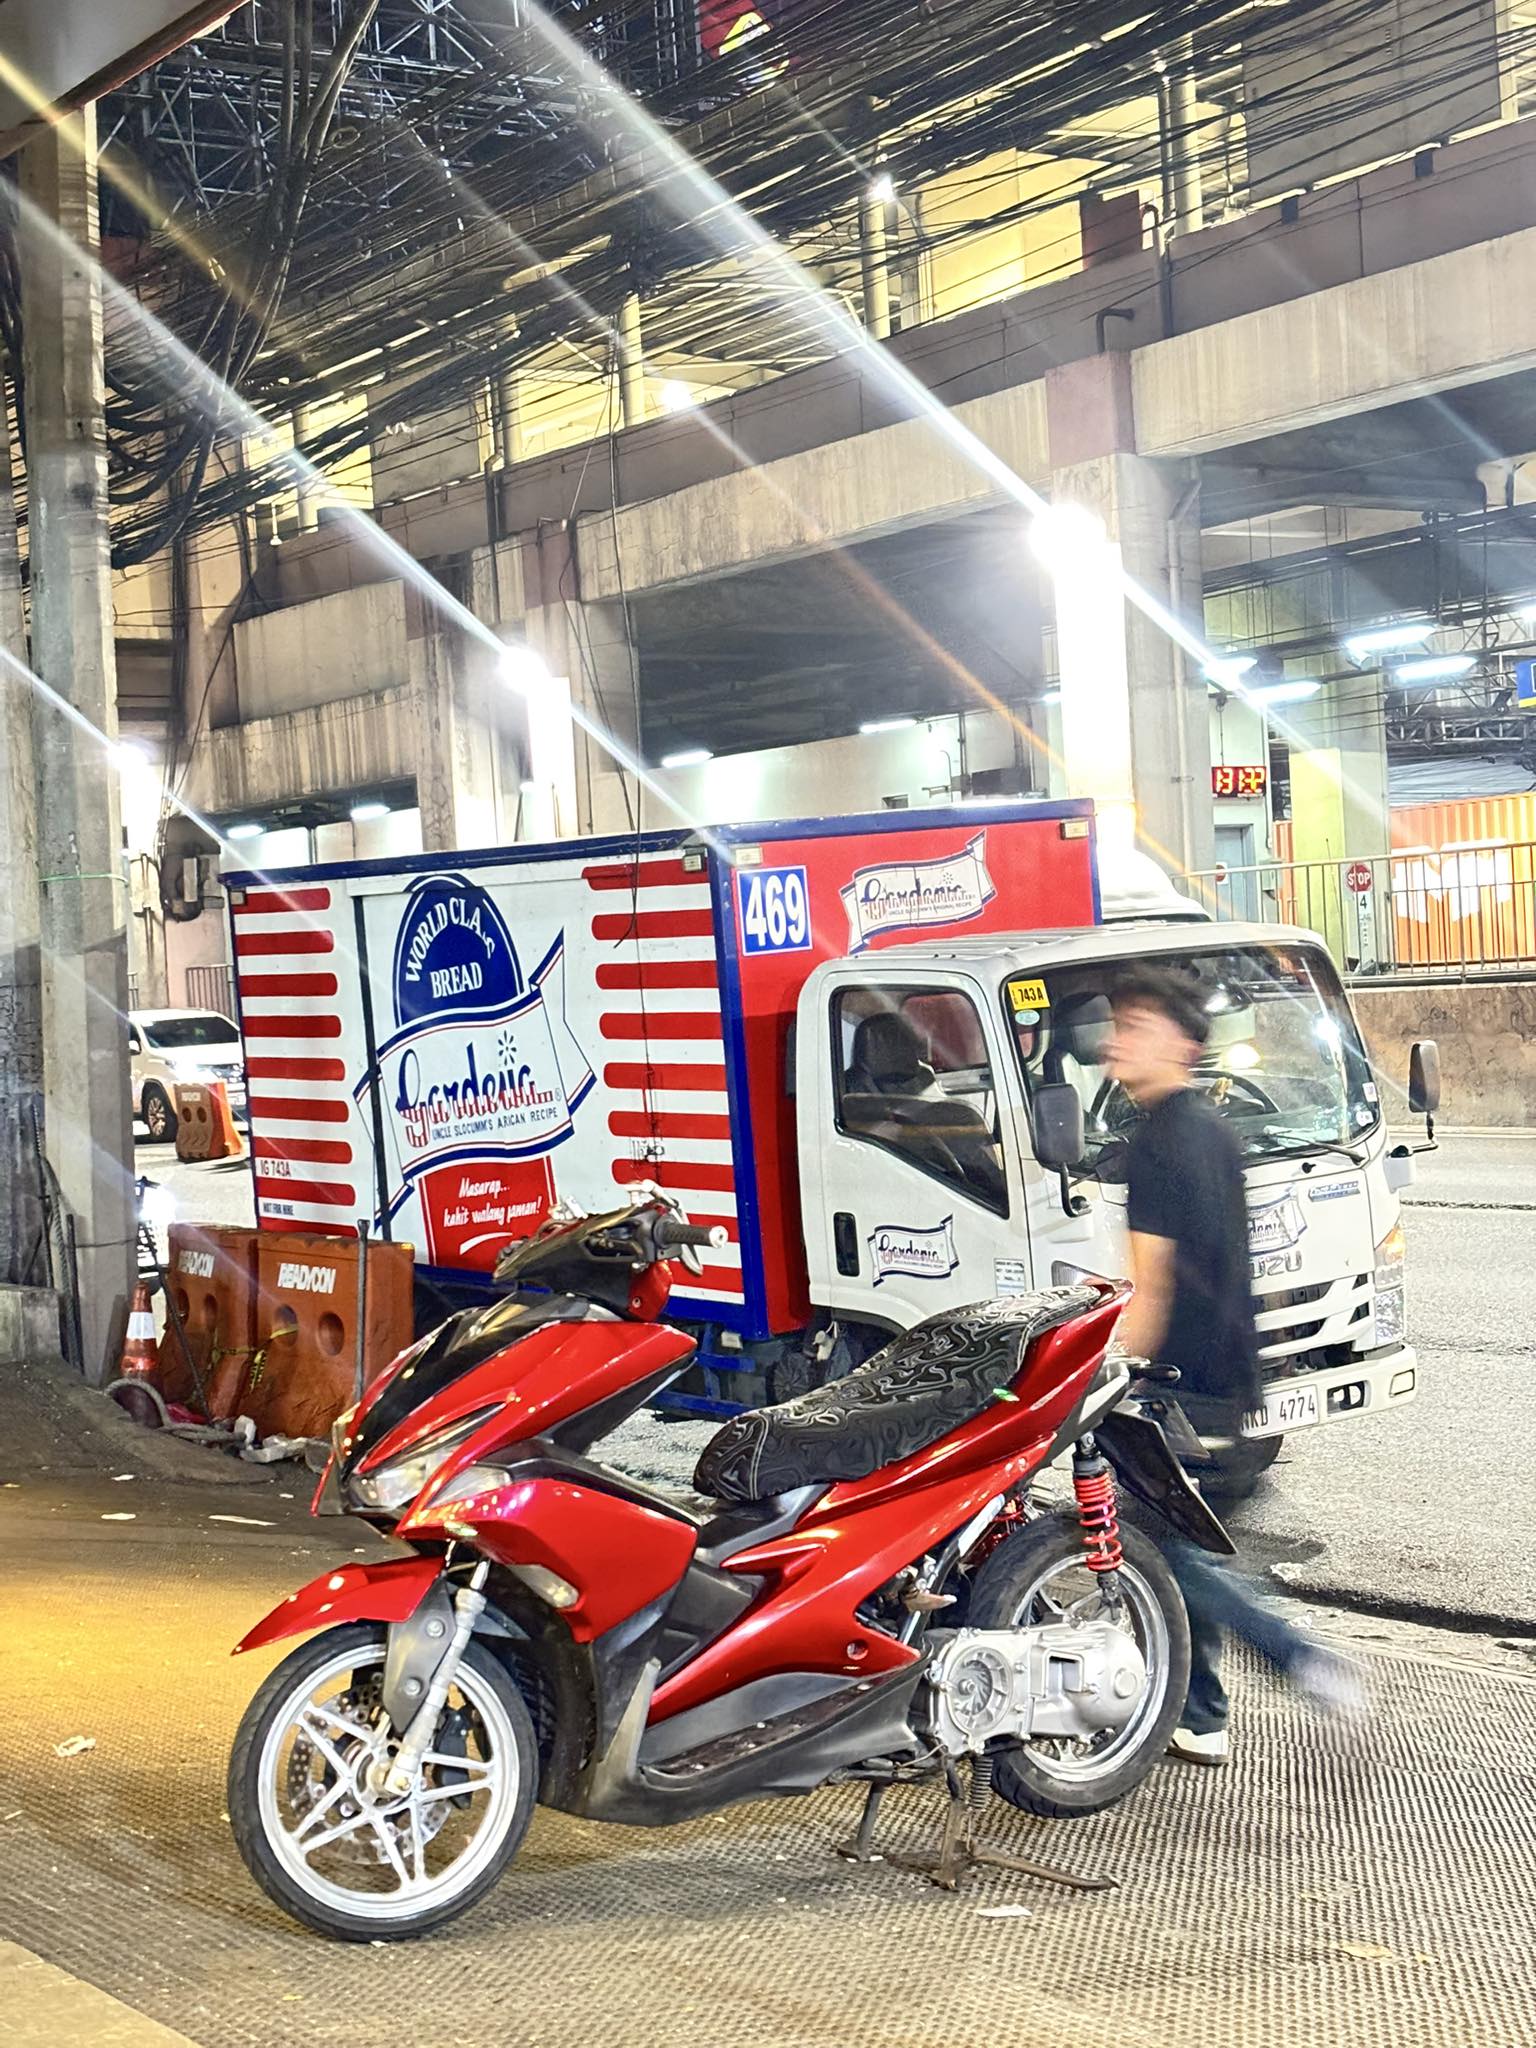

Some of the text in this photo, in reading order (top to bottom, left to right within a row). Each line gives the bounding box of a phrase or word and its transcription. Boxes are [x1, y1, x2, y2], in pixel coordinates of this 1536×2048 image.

[1348, 872, 1371, 885] STOP
[746, 873, 806, 946] 469
[1360, 895, 1367, 909] 4
[406, 903, 448, 982] WORLD
[430, 962, 483, 998] BREAD
[432, 1125, 452, 1140] UNCLE
[530, 1107, 558, 1121] RECIPE
[271, 1160, 292, 1177] 743A
[443, 1206, 470, 1228] kahit
[471, 1202, 505, 1226] walang
[277, 1262, 336, 1294] READYCON
[1249, 1250, 1302, 1280] UZU
[1280, 1394, 1315, 1421] 4774
